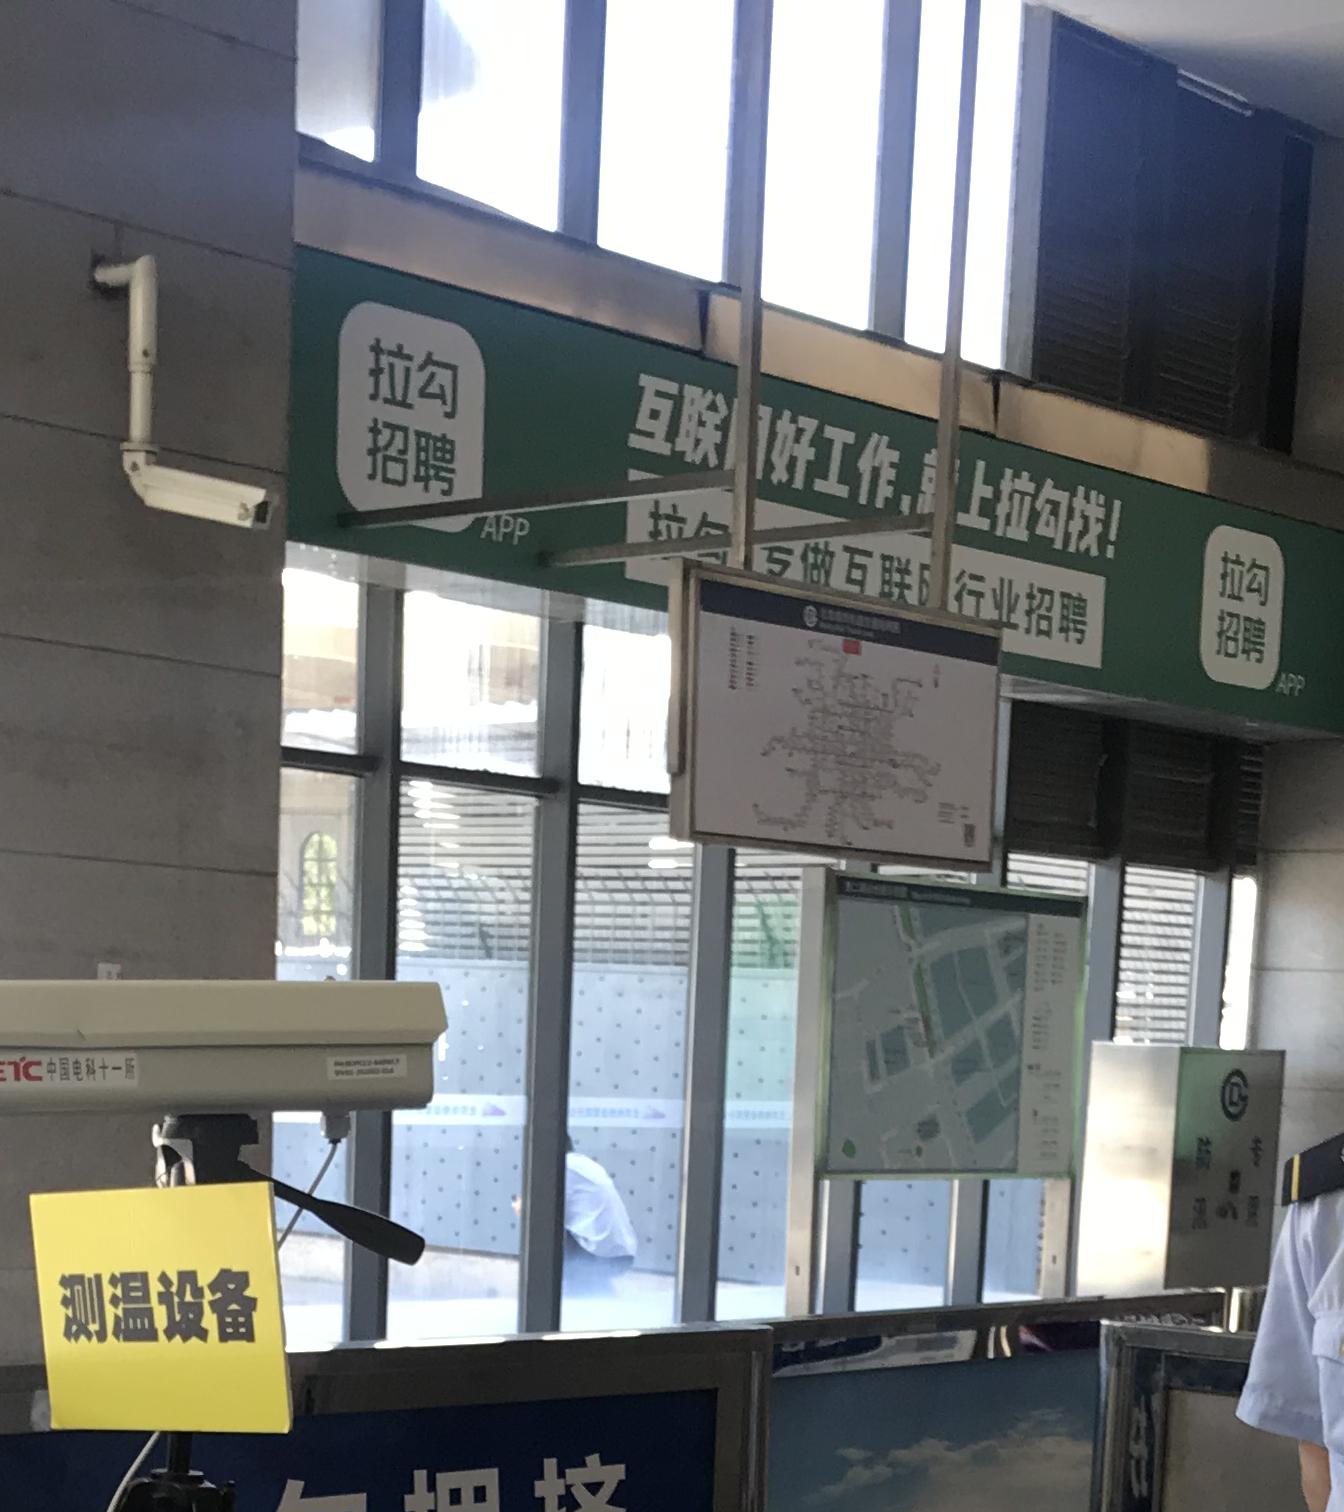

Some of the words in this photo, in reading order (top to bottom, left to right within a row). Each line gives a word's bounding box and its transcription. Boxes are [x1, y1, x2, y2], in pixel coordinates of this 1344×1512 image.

[369, 337, 458, 419] 拉勾
[367, 417, 456, 497] 招聘
[480, 514, 530, 545] APP
[1219, 551, 1270, 606] 拉勾
[1217, 609, 1266, 664] 招聘
[1276, 672, 1306, 697] APP
[59, 1268, 258, 1345] 测温设备
